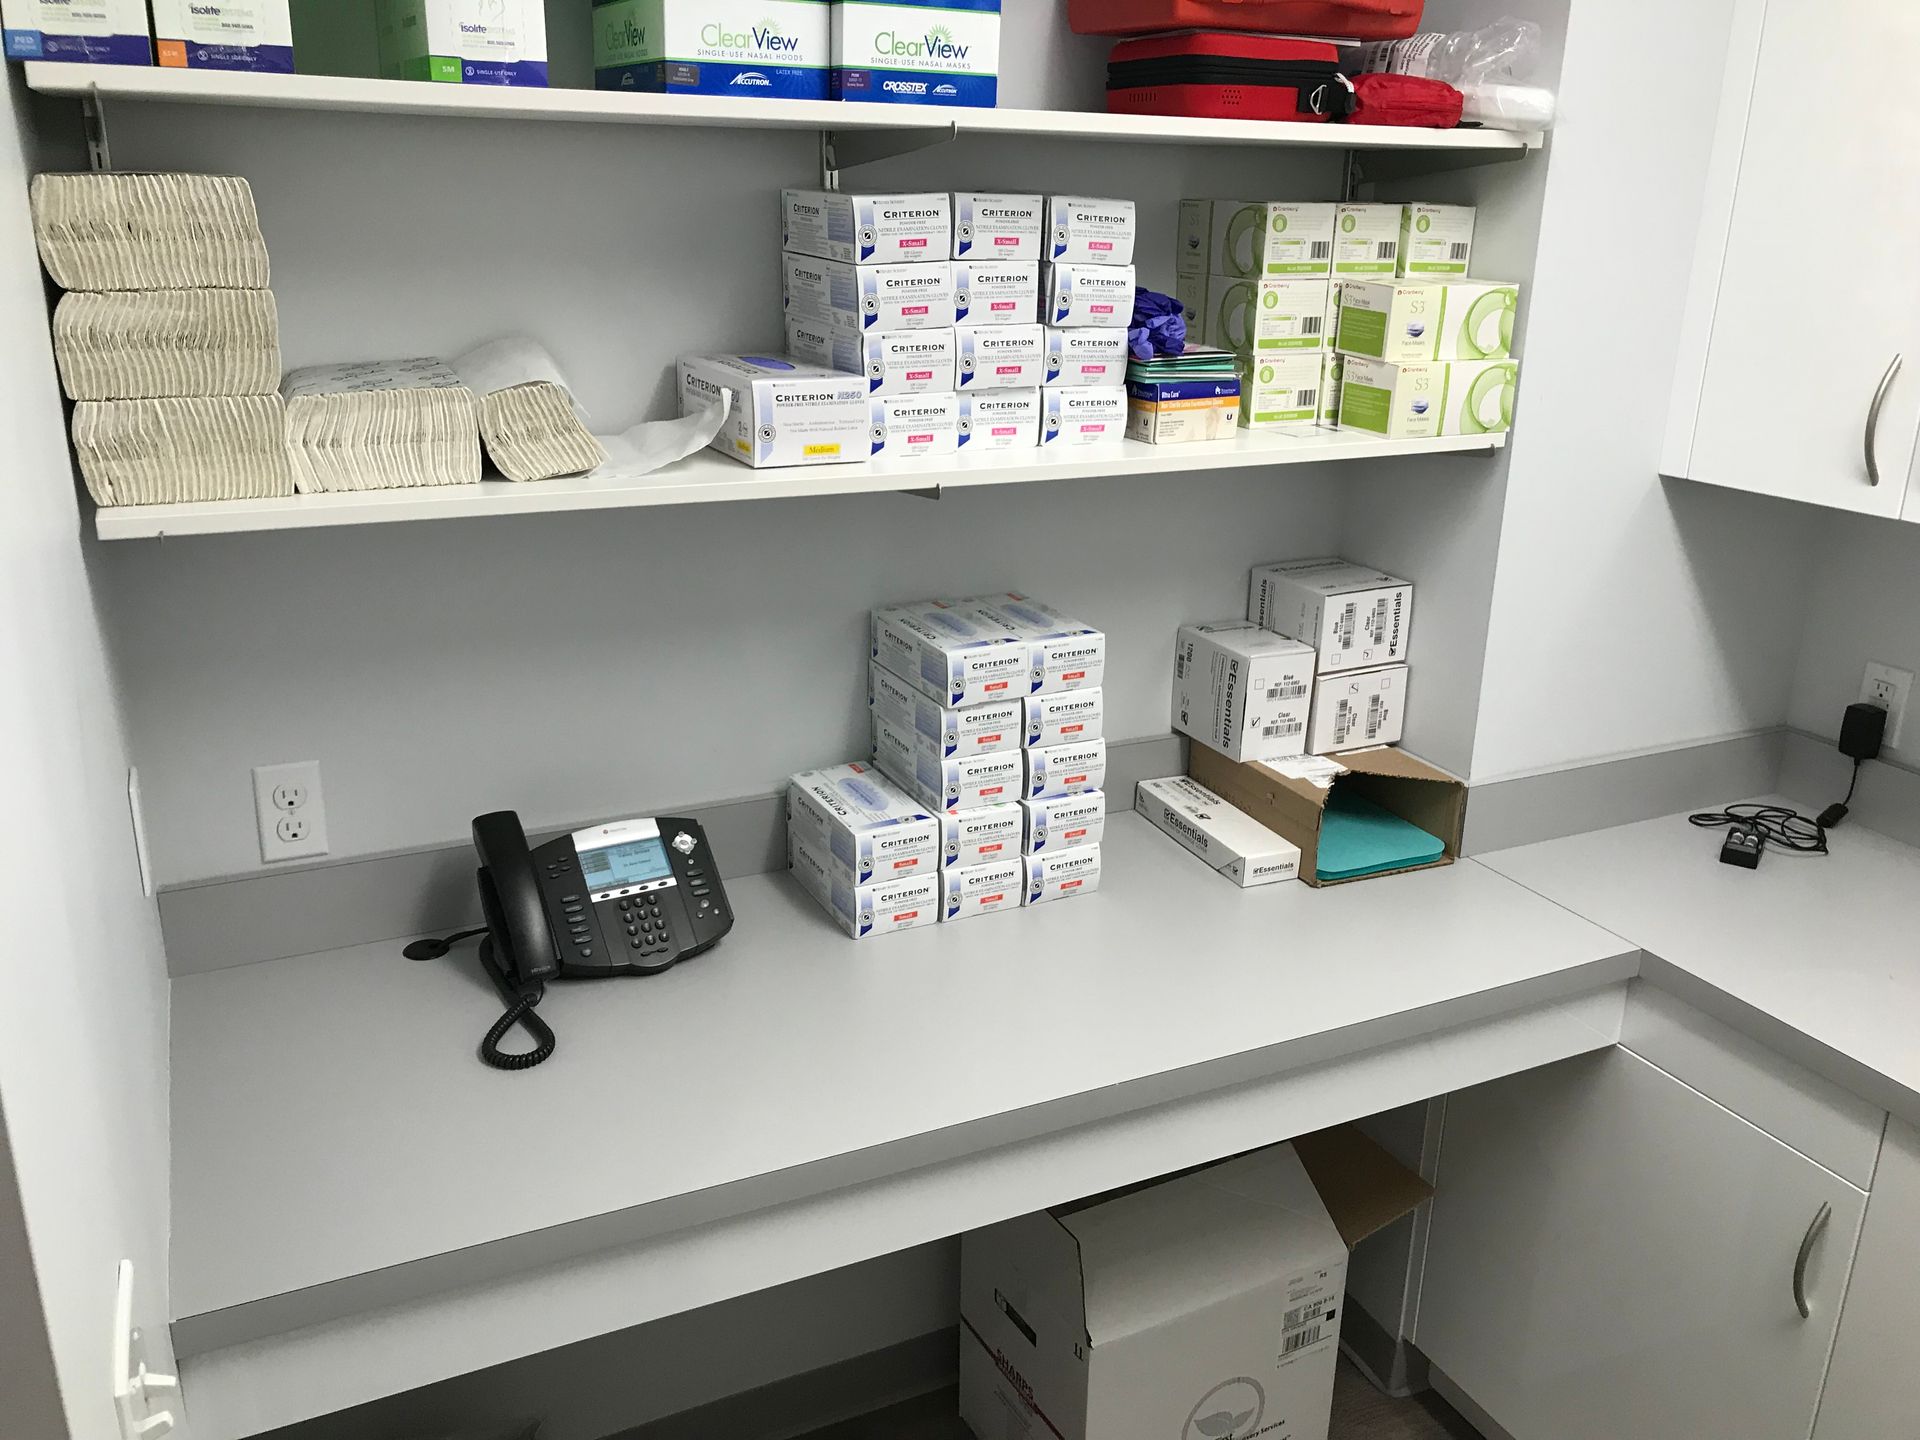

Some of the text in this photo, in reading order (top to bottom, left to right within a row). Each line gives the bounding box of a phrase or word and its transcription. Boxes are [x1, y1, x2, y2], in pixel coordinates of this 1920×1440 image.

[191, 5, 221, 16] isolite
[460, 24, 487, 34] isolite
[701, 23, 799, 52] ClearView
[875, 31, 969, 59] ClearView
[748, 52, 773, 60] NASAL
[776, 53, 804, 62] HOODS
[918, 60, 943, 68] NASAL
[946, 61, 971, 70] MASKS
[730, 72, 770, 86] ACCUTRON
[883, 80, 928, 93] CROSSTEX
[793, 203, 820, 216] CRITERION
[883, 210, 939, 218] CRITERION
[981, 209, 1032, 217] CRITERION
[1076, 214, 1126, 223] CRITERION
[795, 268, 822, 282] CRITERION
[977, 275, 1028, 283] CRITERION
[886, 278, 940, 287] CRITERION
[1079, 278, 1127, 287] CRITERION
[1410, 300, 1425, 313] S3
[797, 330, 825, 345] CRITERION
[983, 339, 1034, 347] CRITERION
[891, 344, 944, 352] CRITERION
[686, 374, 722, 397] CRITERION
[1414, 378, 1429, 391] S3
[775, 393, 834, 402] CRITERION
[893, 408, 947, 416] CRITERION
[979, 402, 1030, 410] CRITERION
[809, 446, 835, 455] Medium
[1390, 591, 1402, 647] Essentials
[884, 629, 913, 653] CRITERION
[1051, 648, 1097, 659] CRITERION
[1186, 642, 1194, 662] 1200
[972, 657, 1019, 670] CRITERION
[880, 679, 908, 704] CRITERION
[1049, 701, 1095, 713] CRITERION
[1222, 672, 1237, 749] Essentials
[965, 711, 1013, 723] CRITERION
[883, 728, 910, 755] CRITERION
[1052, 752, 1098, 764] CRITERION
[967, 763, 1014, 775] CRITERION
[1054, 806, 1098, 819] CRITERION
[966, 820, 1014, 833] CRITERION
[1169, 812, 1209, 848] Essentials
[881, 834, 930, 848] CRITERION
[1050, 857, 1093, 871] CRITERION
[1259, 862, 1294, 874] Essentials
[968, 871, 1014, 885] CRITERION
[881, 887, 929, 902] CRITERION
[1260, 1420, 1286, 1434] Services
